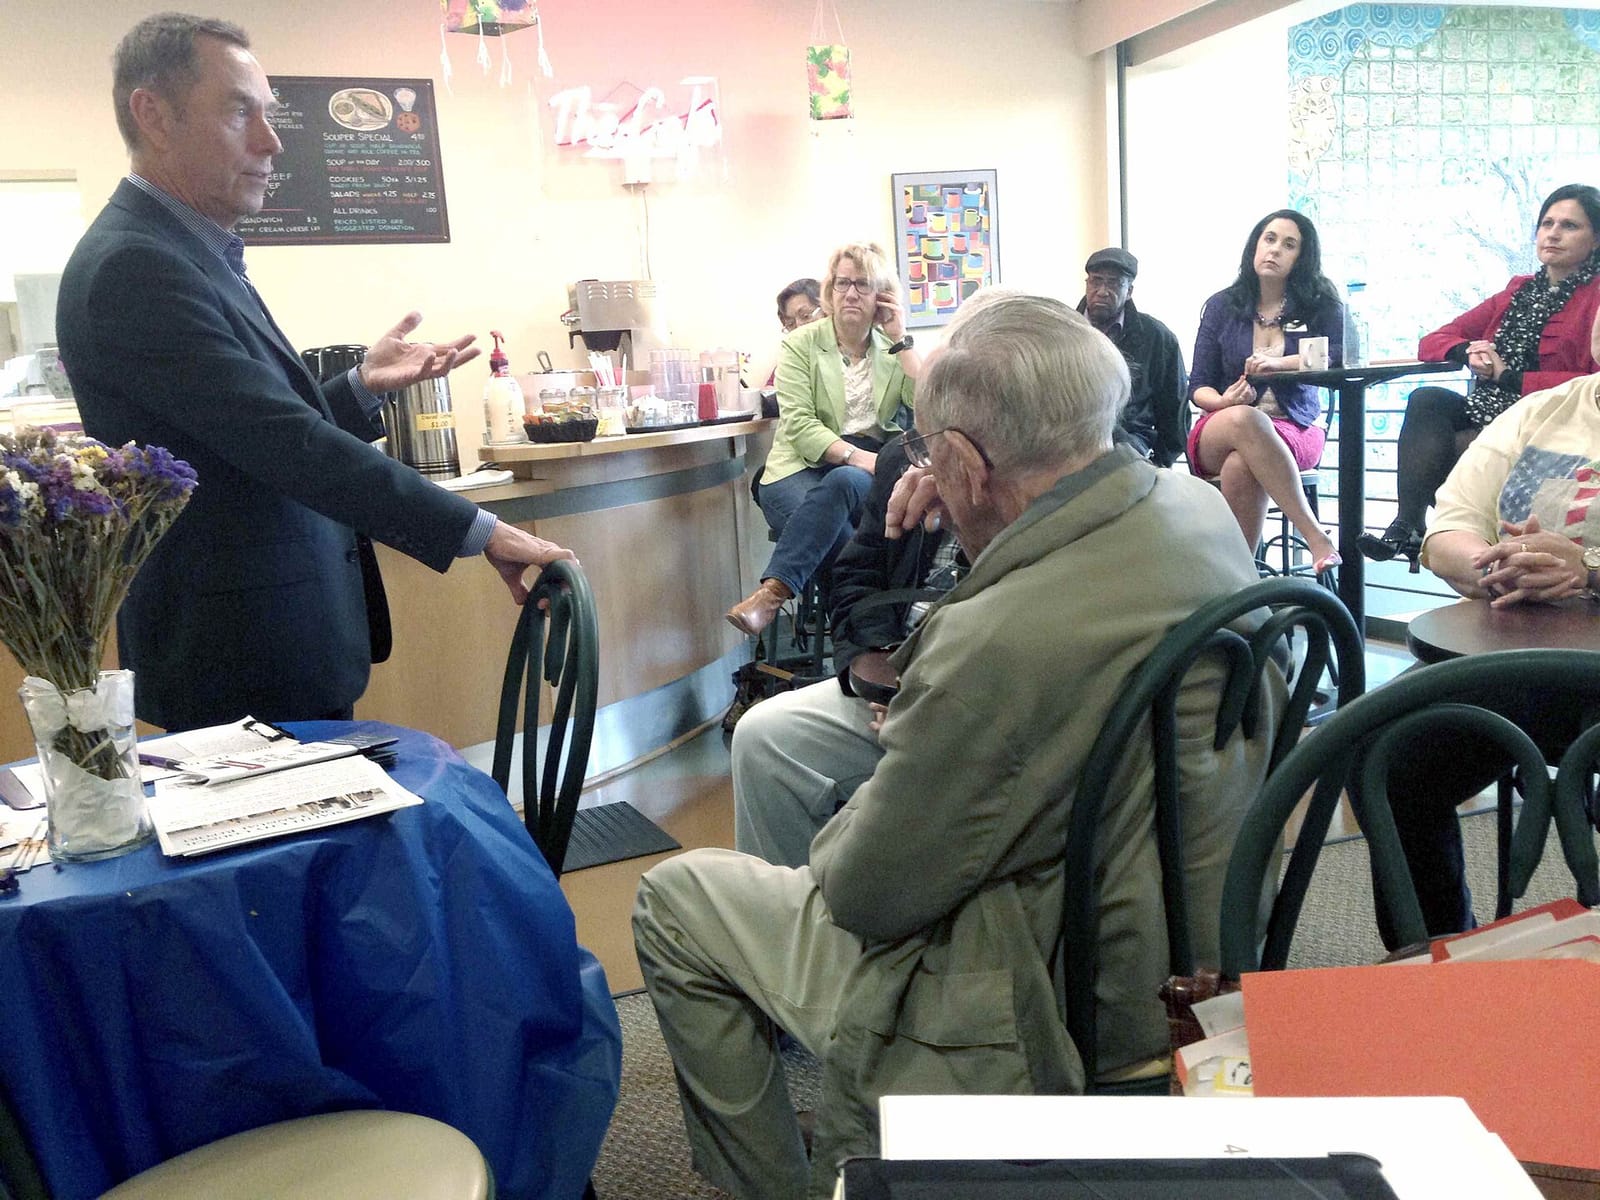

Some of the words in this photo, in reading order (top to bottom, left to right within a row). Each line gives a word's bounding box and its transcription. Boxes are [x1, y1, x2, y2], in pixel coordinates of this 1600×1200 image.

[322, 132, 355, 141] SOUPER
[357, 132, 393, 142] SPECIAL
[326, 158, 346, 166] SOUP
[329, 190, 360, 198] SALADS
[333, 207, 347, 215] ALL
[348, 207, 378, 215] DRINKS
[258, 225, 285, 233] CREAM
